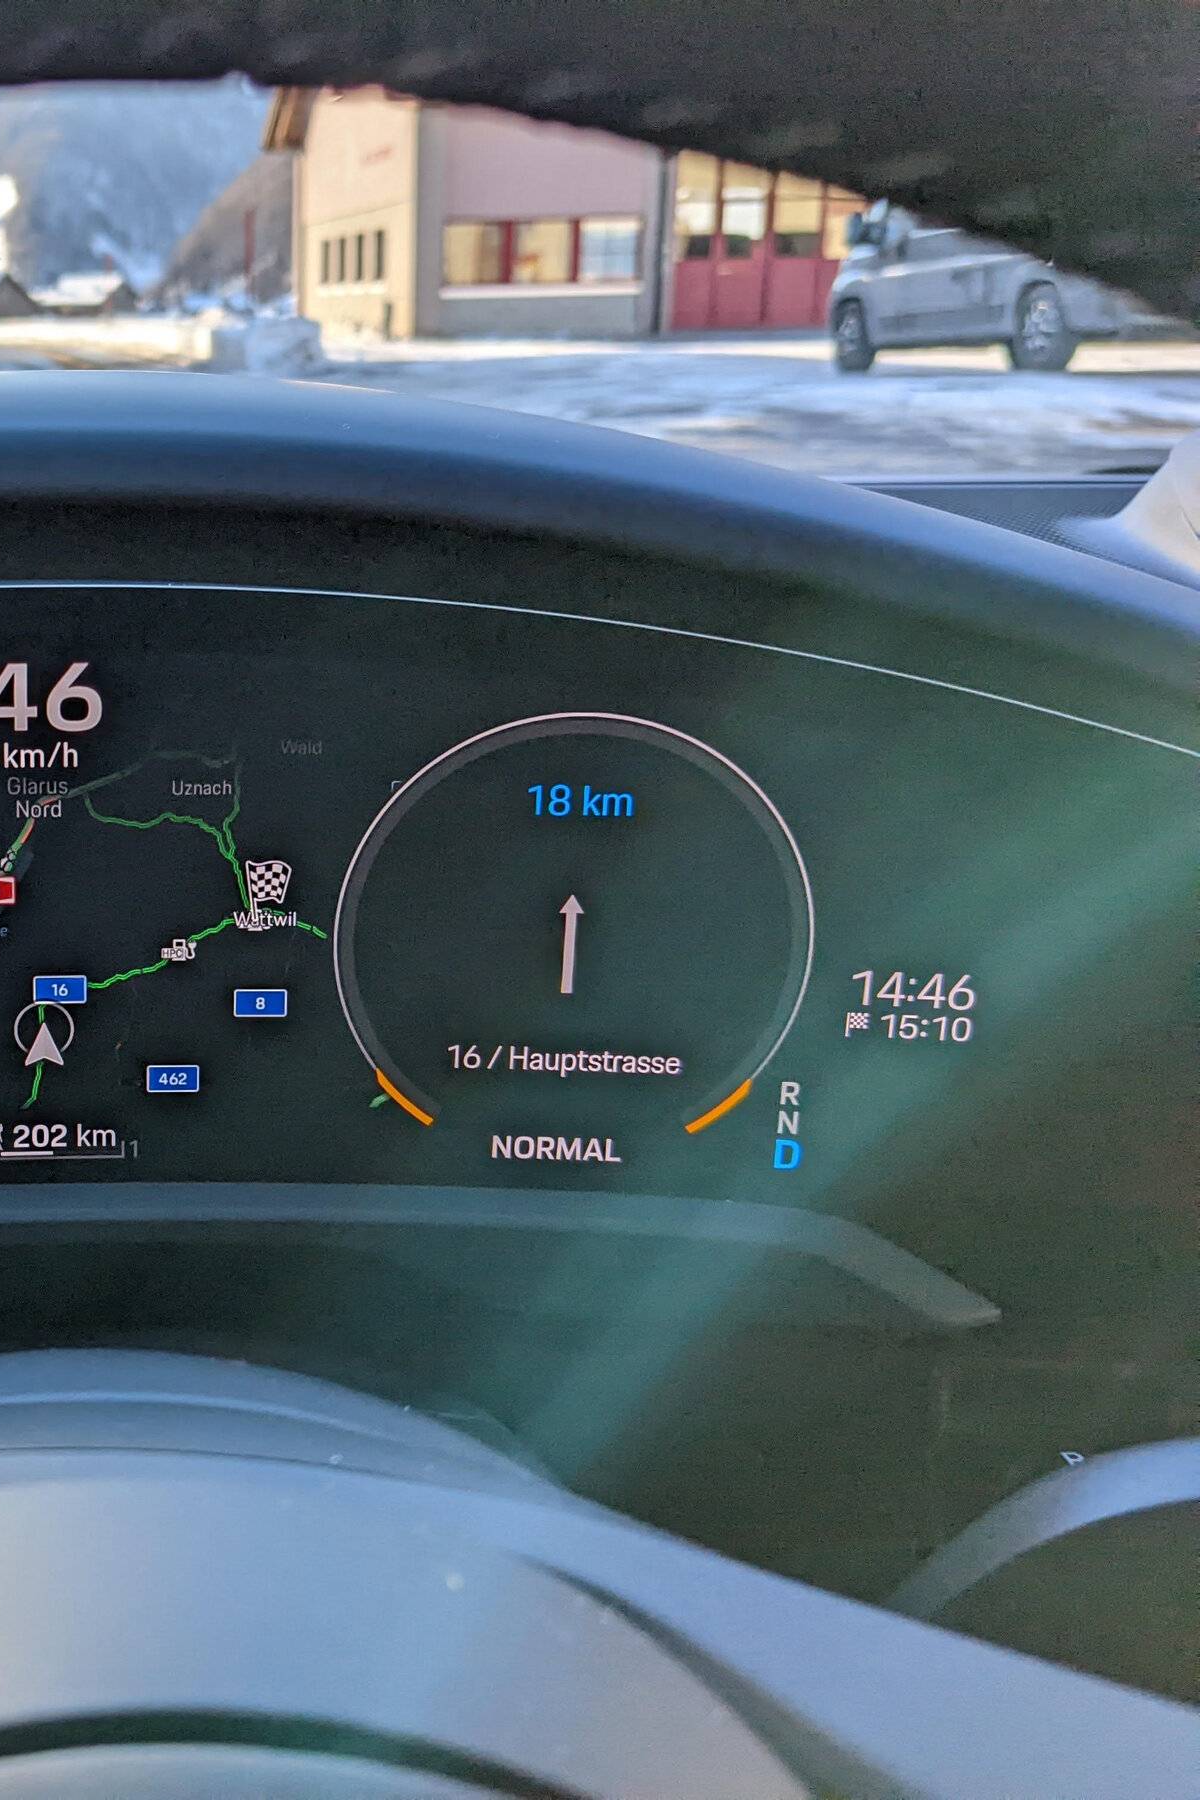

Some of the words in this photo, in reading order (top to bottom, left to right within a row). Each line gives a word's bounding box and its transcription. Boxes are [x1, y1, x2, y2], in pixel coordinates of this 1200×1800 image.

[3, 741, 79, 769] km/h
[281, 739, 323, 754] Wald
[7, 776, 69, 795] Glarus
[171, 780, 233, 796] Uznach
[16, 800, 62, 818] Nord
[528, 784, 573, 818] 18
[582, 785, 635, 818] km
[51, 983, 69, 997] 16
[850, 971, 975, 1012] 14:46
[255, 997, 266, 1010] 8
[880, 1014, 973, 1042] 15:10
[448, 1044, 482, 1070] 16
[509, 1045, 682, 1079] Hauptstrasse
[158, 1072, 189, 1087] 462
[779, 1080, 801, 1106] R
[776, 1111, 800, 1135] N
[13, 1124, 68, 1149] 202
[77, 1123, 117, 1148] km
[129, 1140, 140, 1159] 1
[490, 1135, 622, 1163] NORMAL
[772, 1139, 802, 1169] D
